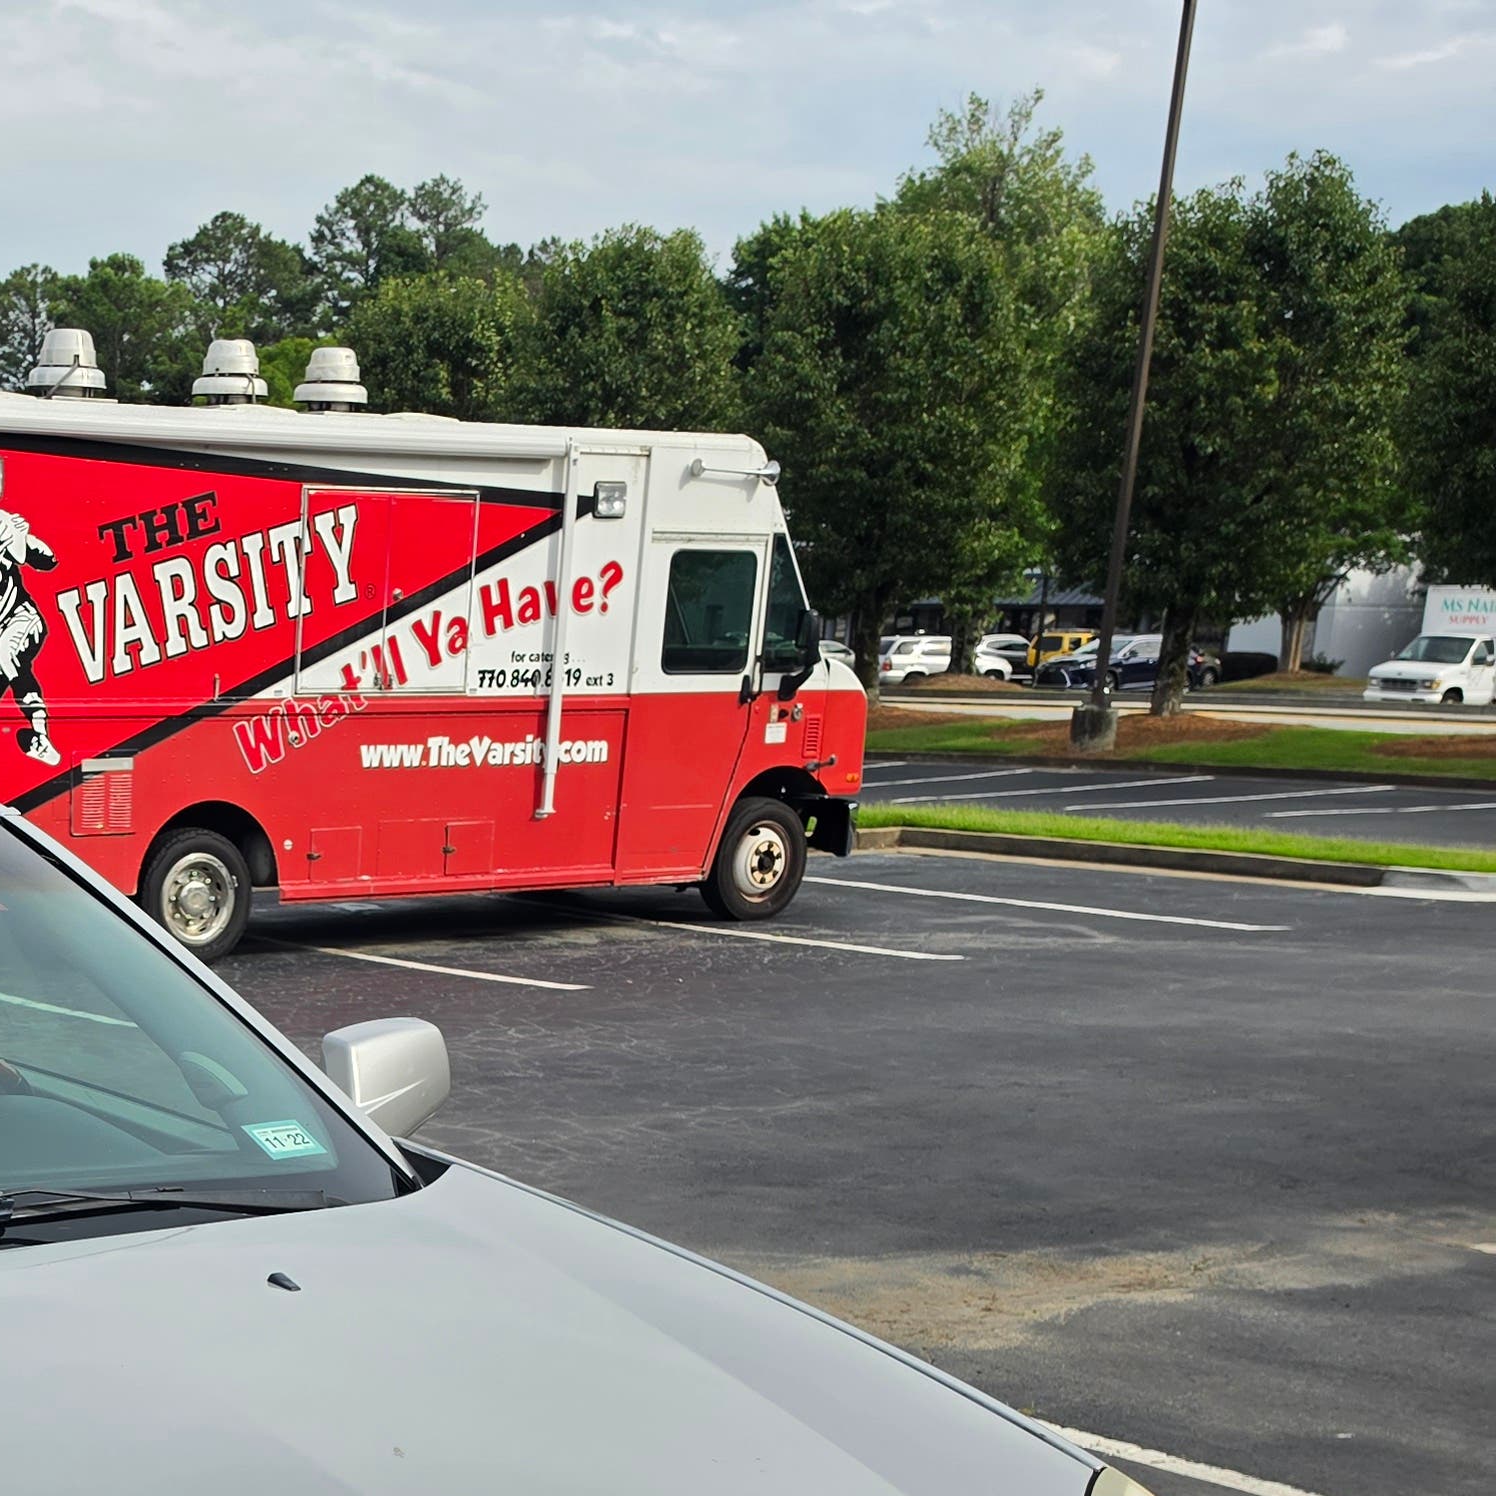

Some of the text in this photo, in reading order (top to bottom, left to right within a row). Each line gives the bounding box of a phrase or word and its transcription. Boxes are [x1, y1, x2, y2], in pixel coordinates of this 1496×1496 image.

[97, 490, 222, 563] THE
[56, 503, 359, 685] VARSITY
[1441, 597, 1496, 614] MS NAI
[511, 651, 526, 663] for
[585, 674, 603, 687] ext
[607, 672, 615, 687] 3
[232, 634, 409, 774] What'll
[410, 609, 470, 669] Ya
